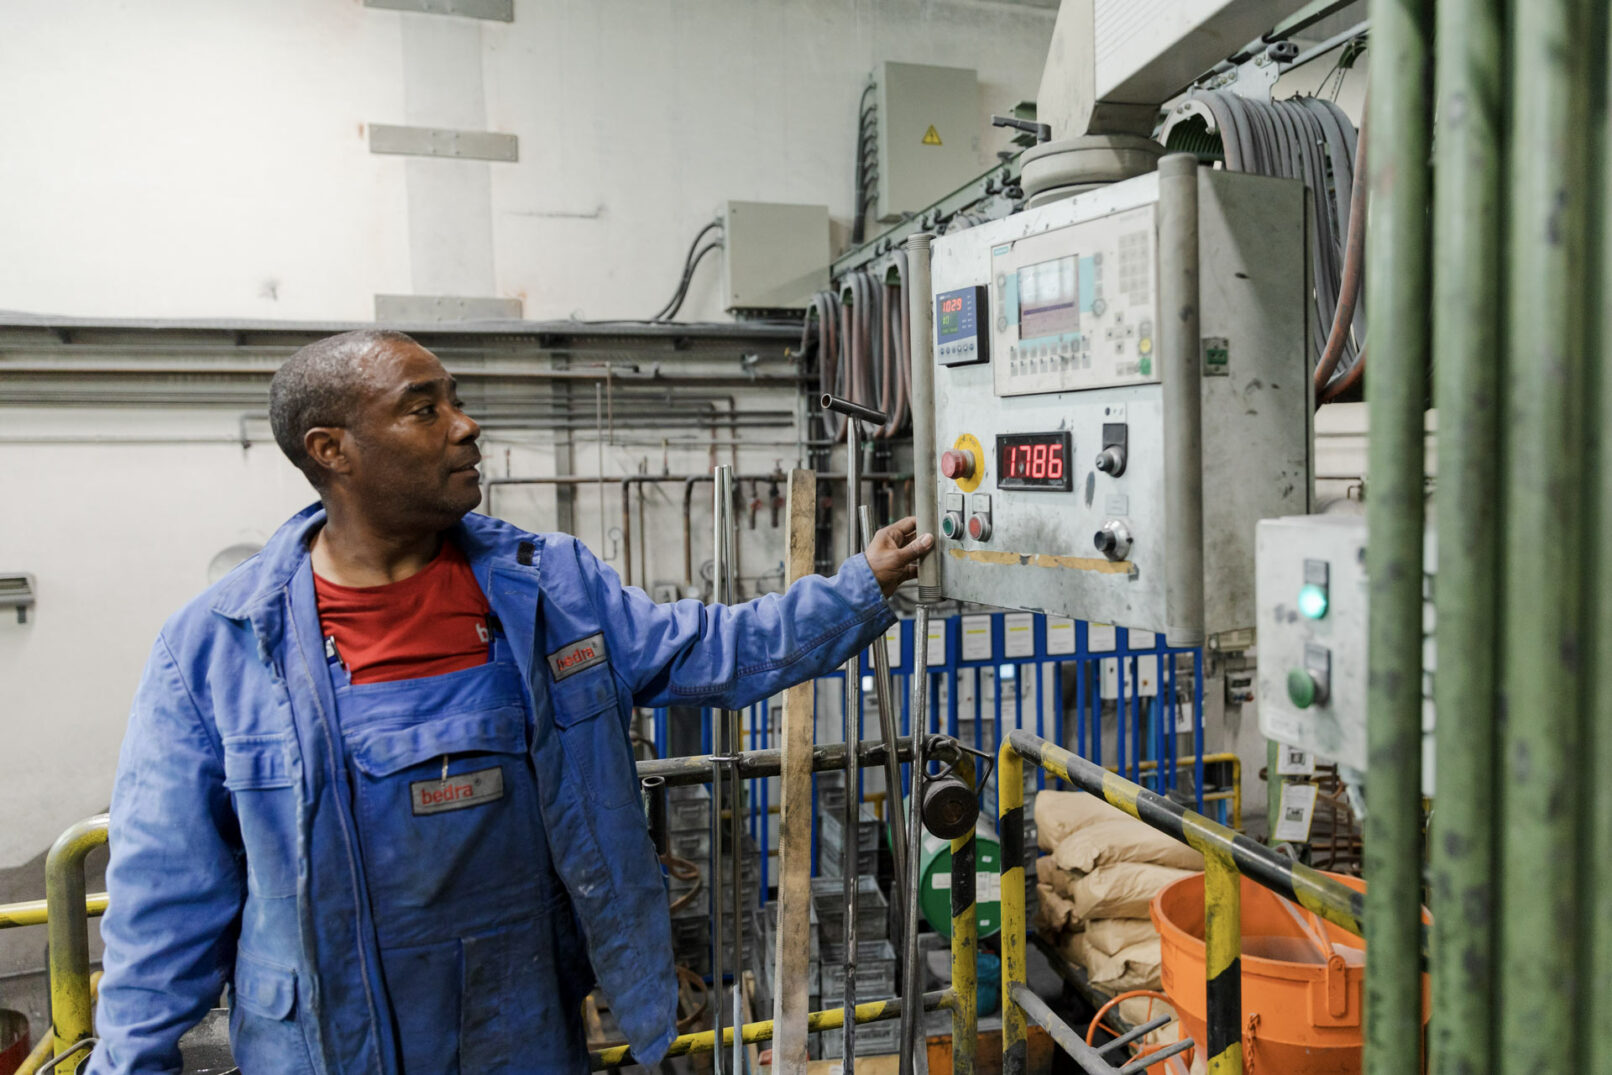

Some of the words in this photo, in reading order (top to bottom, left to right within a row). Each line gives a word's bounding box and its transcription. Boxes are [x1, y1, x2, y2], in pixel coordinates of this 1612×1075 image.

[942, 297, 963, 313] 1029
[1010, 443, 1063, 479] 1786
[556, 647, 596, 672] bedra
[421, 783, 473, 805] bedra
